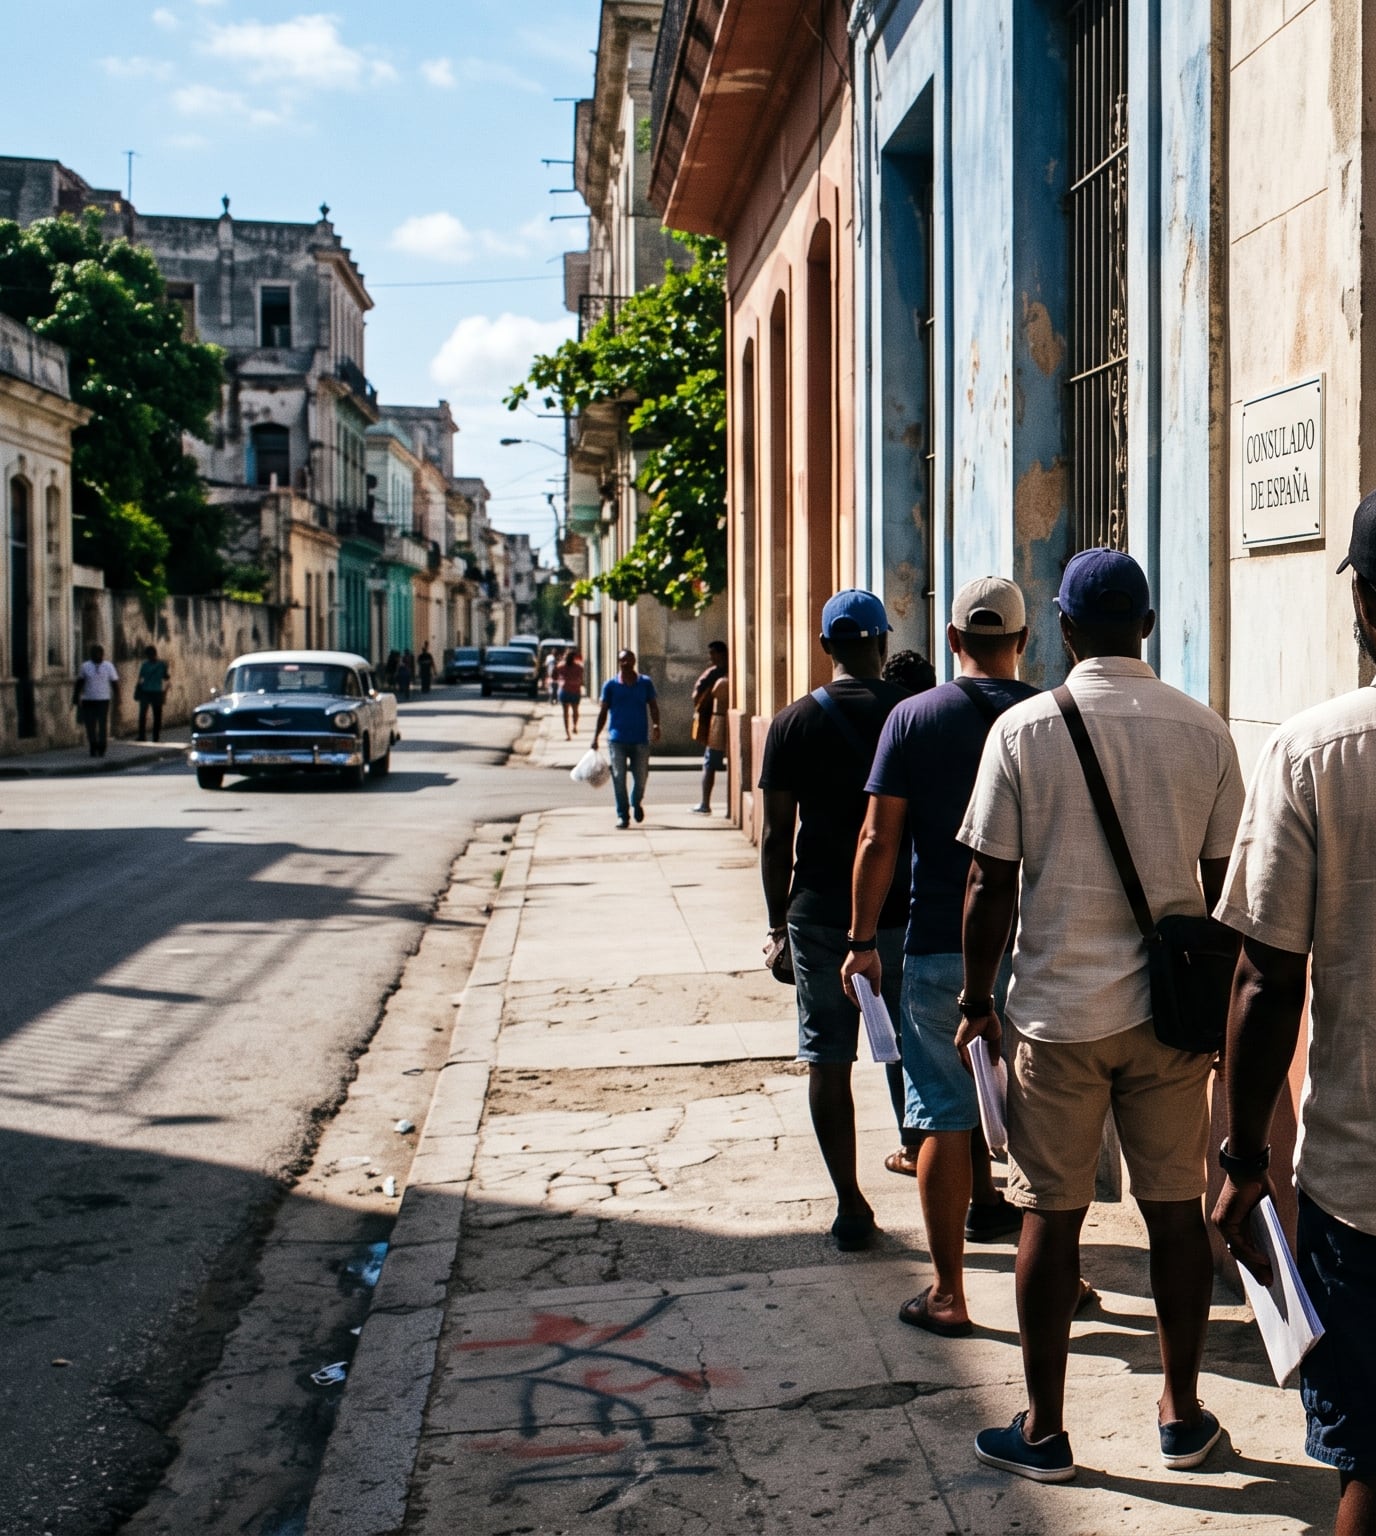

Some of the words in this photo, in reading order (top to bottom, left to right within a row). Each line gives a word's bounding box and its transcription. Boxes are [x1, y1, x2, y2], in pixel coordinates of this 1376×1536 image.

[1246, 418, 1315, 464] CONSULADO
[1250, 481, 1264, 511] DE
[1267, 466, 1310, 508] ESPAÑA
